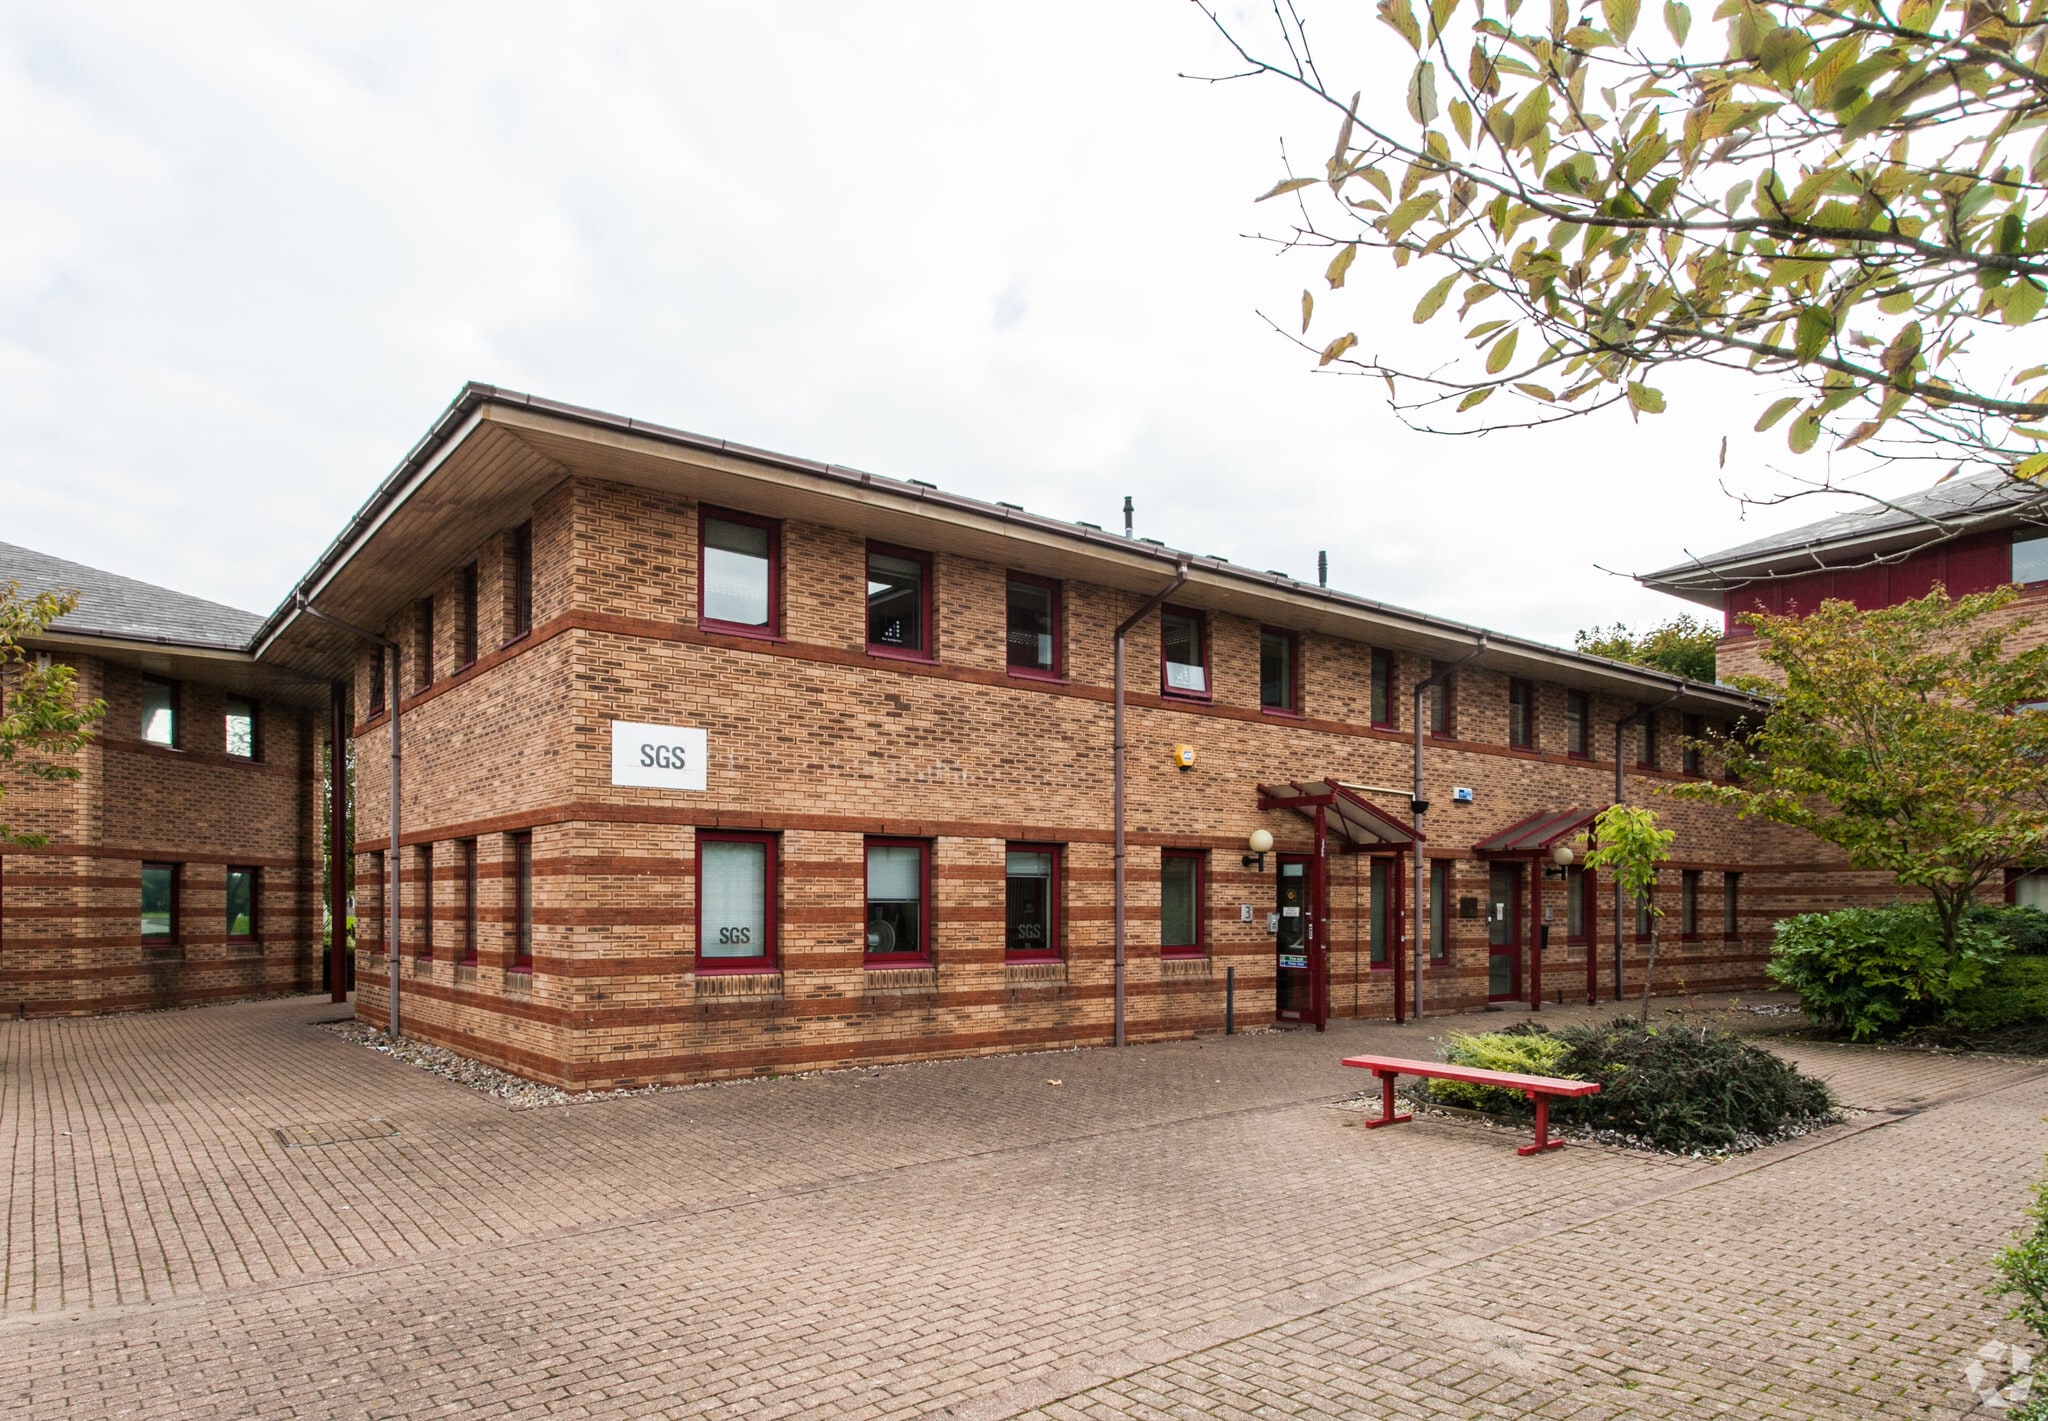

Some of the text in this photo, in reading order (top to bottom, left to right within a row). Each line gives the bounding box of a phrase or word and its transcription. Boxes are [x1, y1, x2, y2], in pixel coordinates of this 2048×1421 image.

[640, 743, 686, 770] SGS
[1245, 906, 1251, 919] 3
[719, 926, 751, 945] SGS
[1018, 923, 1041, 939] SGS
